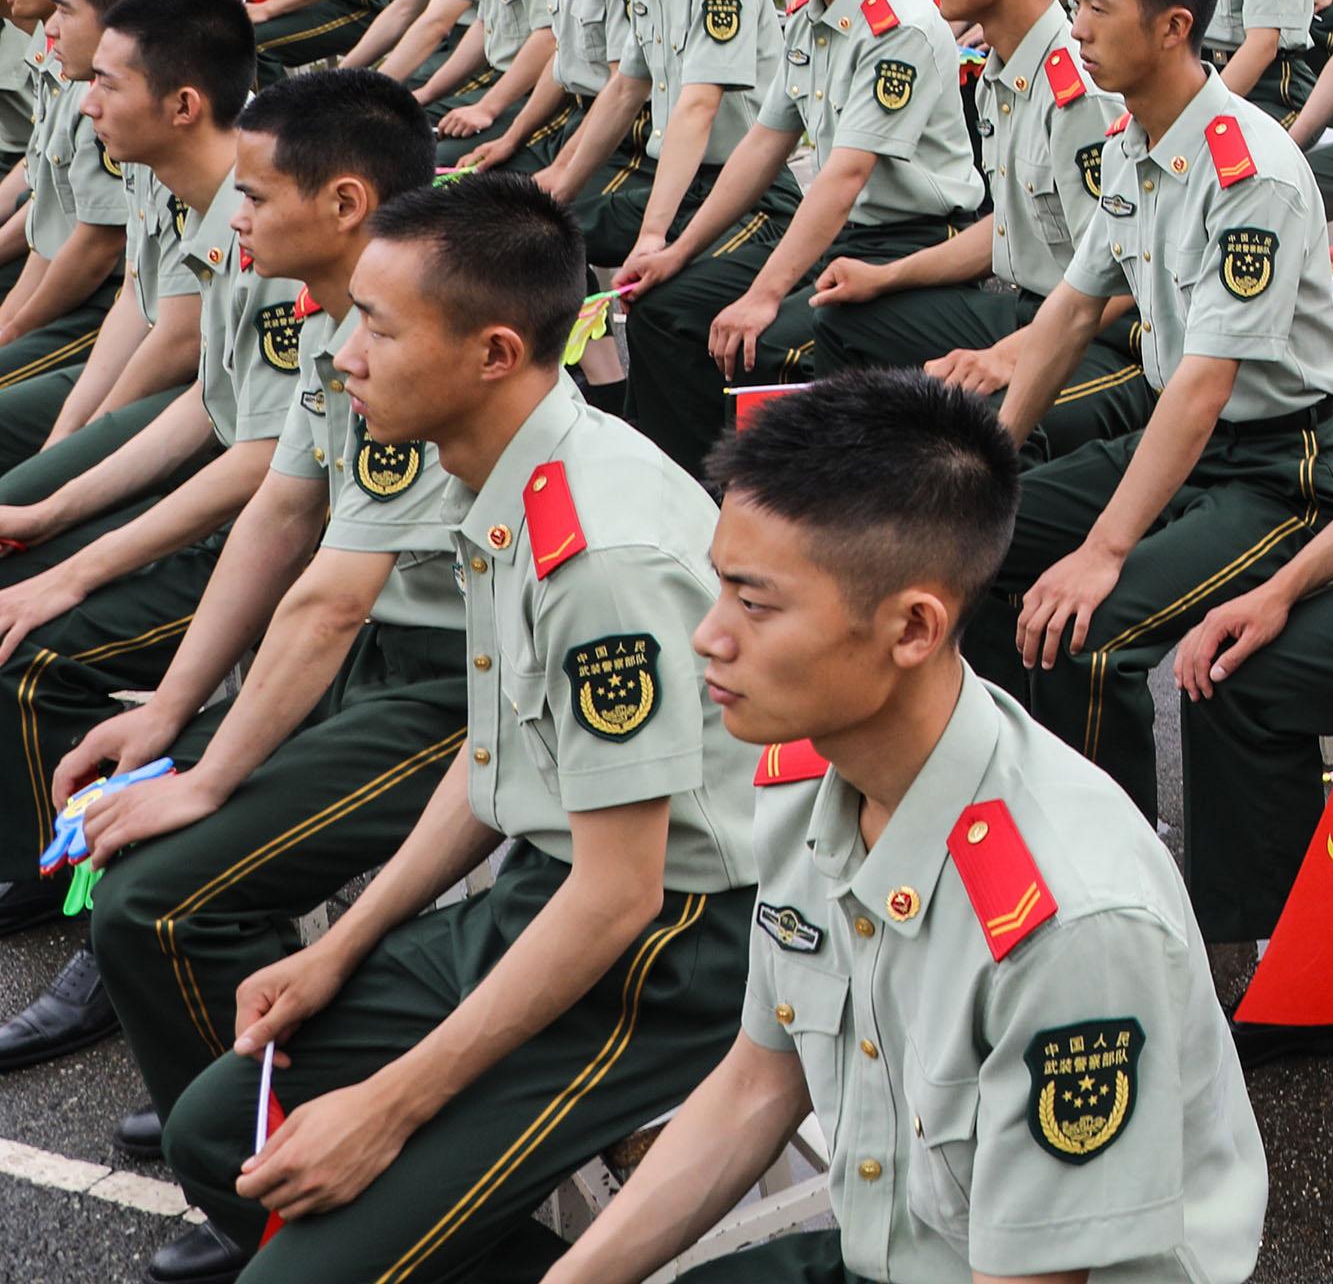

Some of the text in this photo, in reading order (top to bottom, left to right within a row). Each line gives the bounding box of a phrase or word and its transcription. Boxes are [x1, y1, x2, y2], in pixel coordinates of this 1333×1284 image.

[1044, 1030, 1131, 1058] 中国人民
[1044, 1048, 1129, 1076] 武装警察部队
